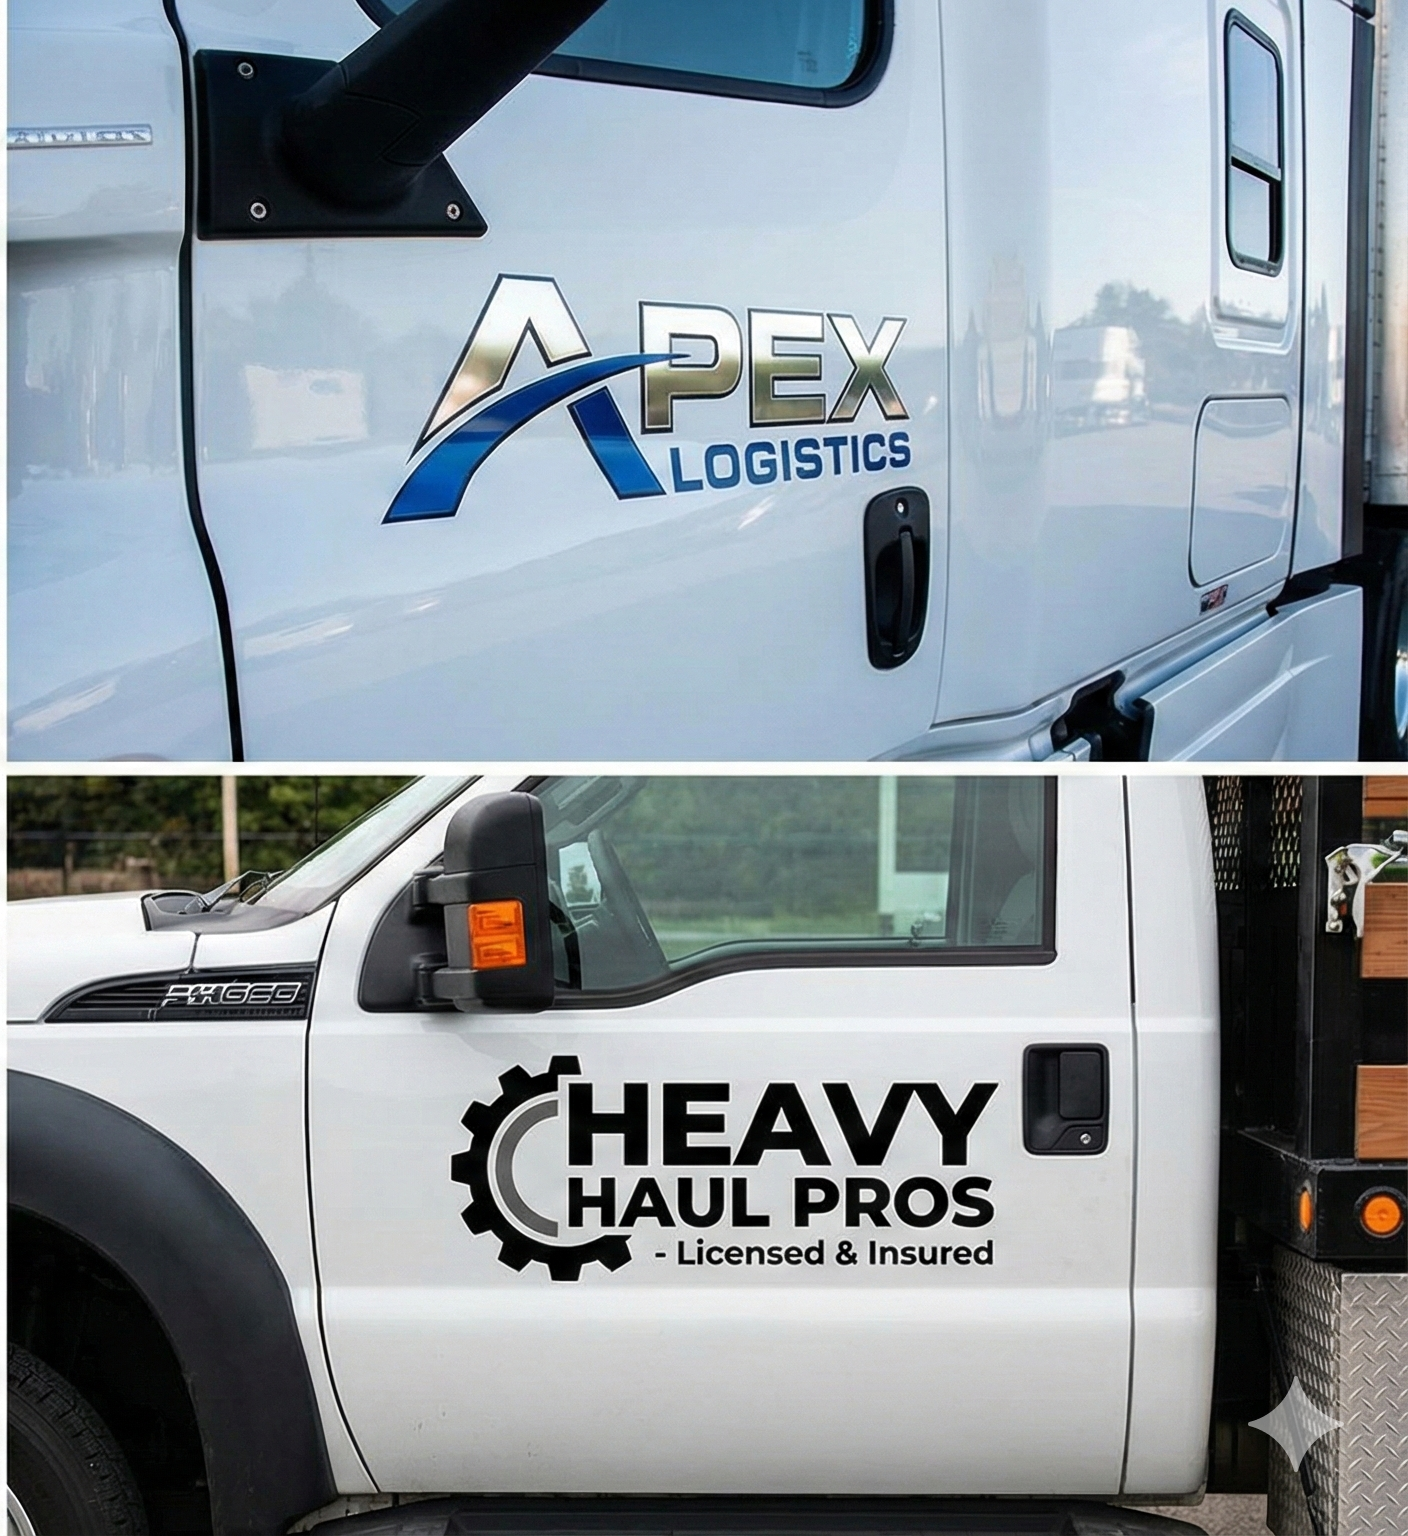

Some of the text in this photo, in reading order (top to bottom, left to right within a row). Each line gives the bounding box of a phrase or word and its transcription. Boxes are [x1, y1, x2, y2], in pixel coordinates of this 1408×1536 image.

[381, 273, 910, 525] APEX
[669, 431, 911, 493] LOGISTICS
[568, 1082, 999, 1166] HEAVY
[568, 1175, 995, 1229] HAUL PROS
[677, 1238, 825, 1266] Licensed
[835, 1240, 859, 1266] &
[868, 1239, 994, 1266] Insured
